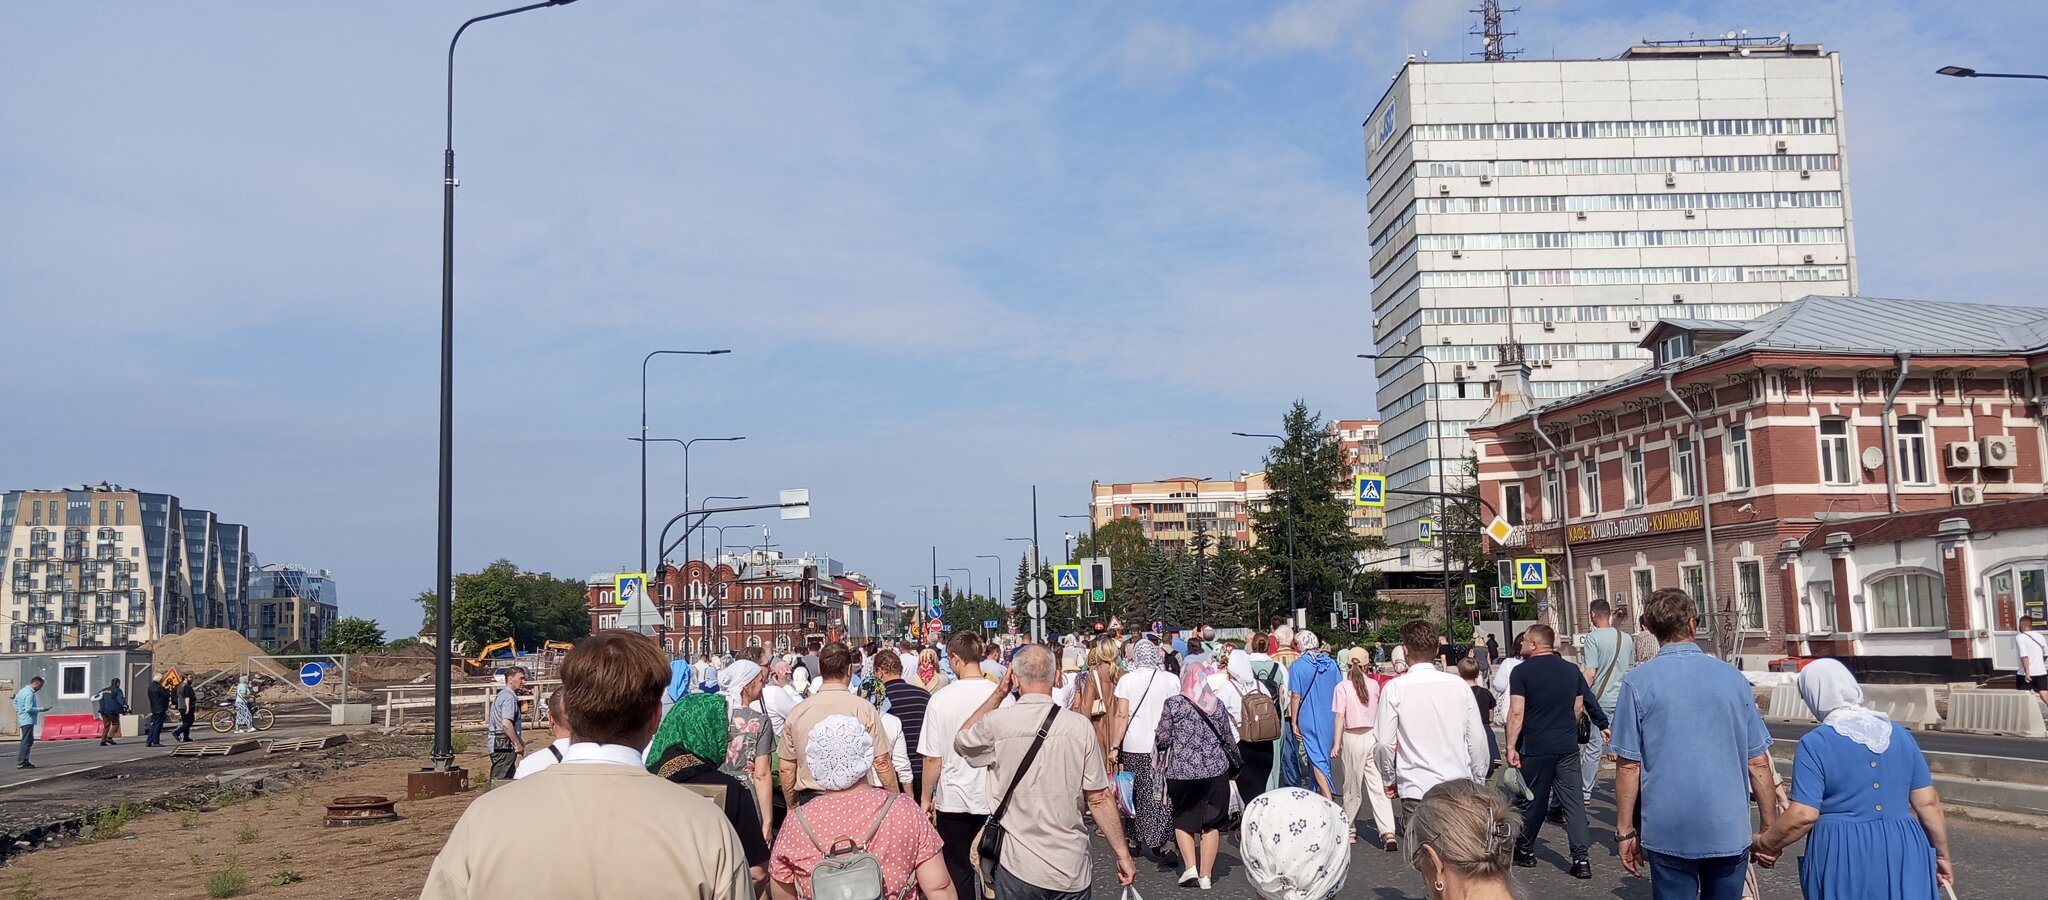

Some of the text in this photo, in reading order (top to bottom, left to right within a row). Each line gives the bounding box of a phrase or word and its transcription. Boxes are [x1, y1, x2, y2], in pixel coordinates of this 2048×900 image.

[1568, 509, 1700, 541] КАФЕ КУШАТЬ ПОДАНО КУЛИНАРИЯ
